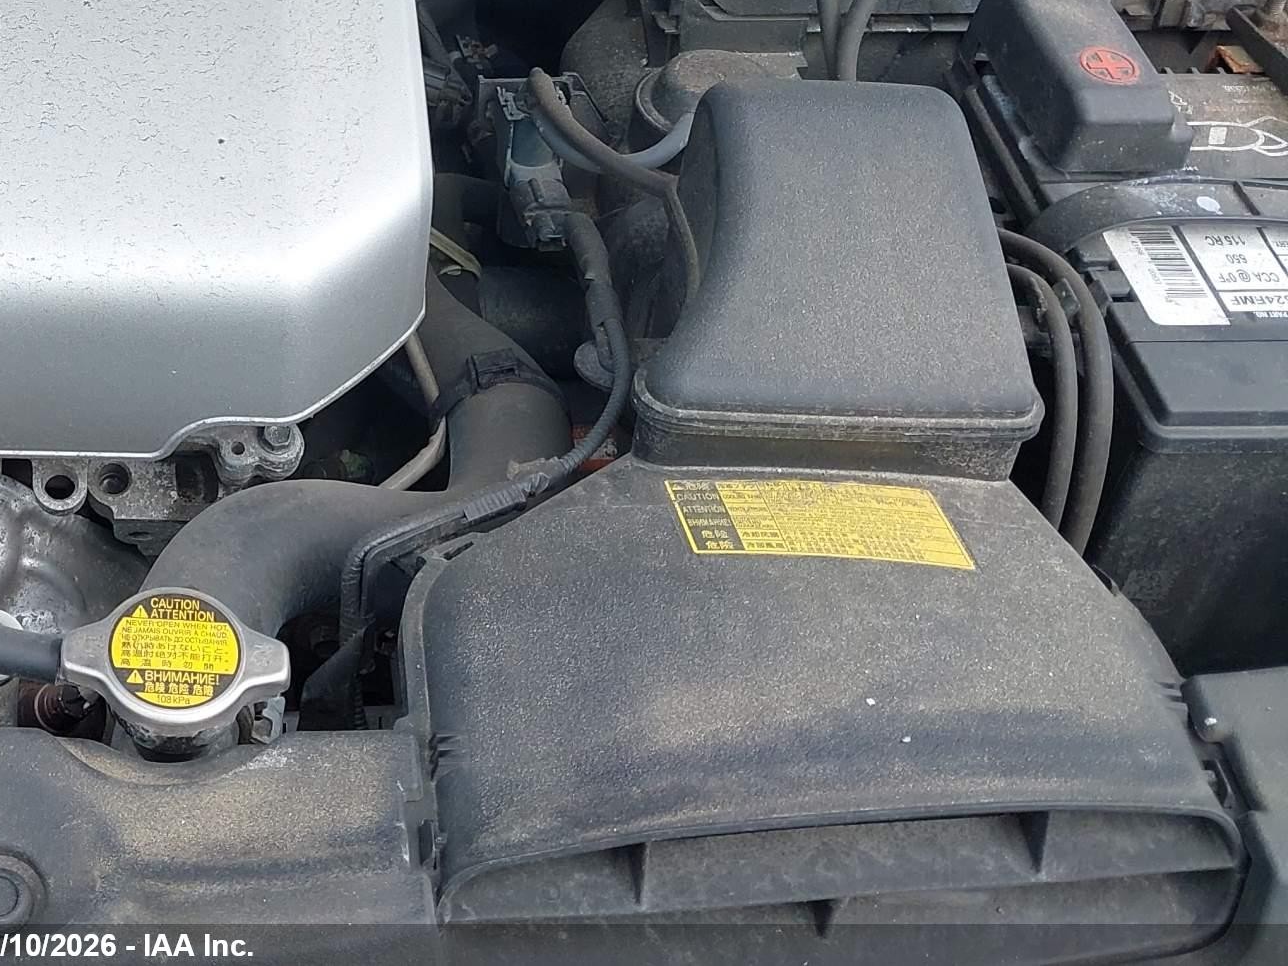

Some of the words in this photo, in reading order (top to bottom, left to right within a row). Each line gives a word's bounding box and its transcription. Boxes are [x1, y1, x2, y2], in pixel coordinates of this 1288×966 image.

[1255, 272, 1280, 283] CCA
[676, 493, 721, 501] CAUTION
[682, 505, 727, 514] ATTENTION
[150, 597, 200, 611] CAUTION
[150, 609, 215, 622] ATTENTION
[126, 619, 154, 627] NEVER
[133, 627, 161, 635] JAMAIS
[162, 628, 192, 636] OUVRIR
[144, 670, 220, 686] ВНИМАНИЕ!
